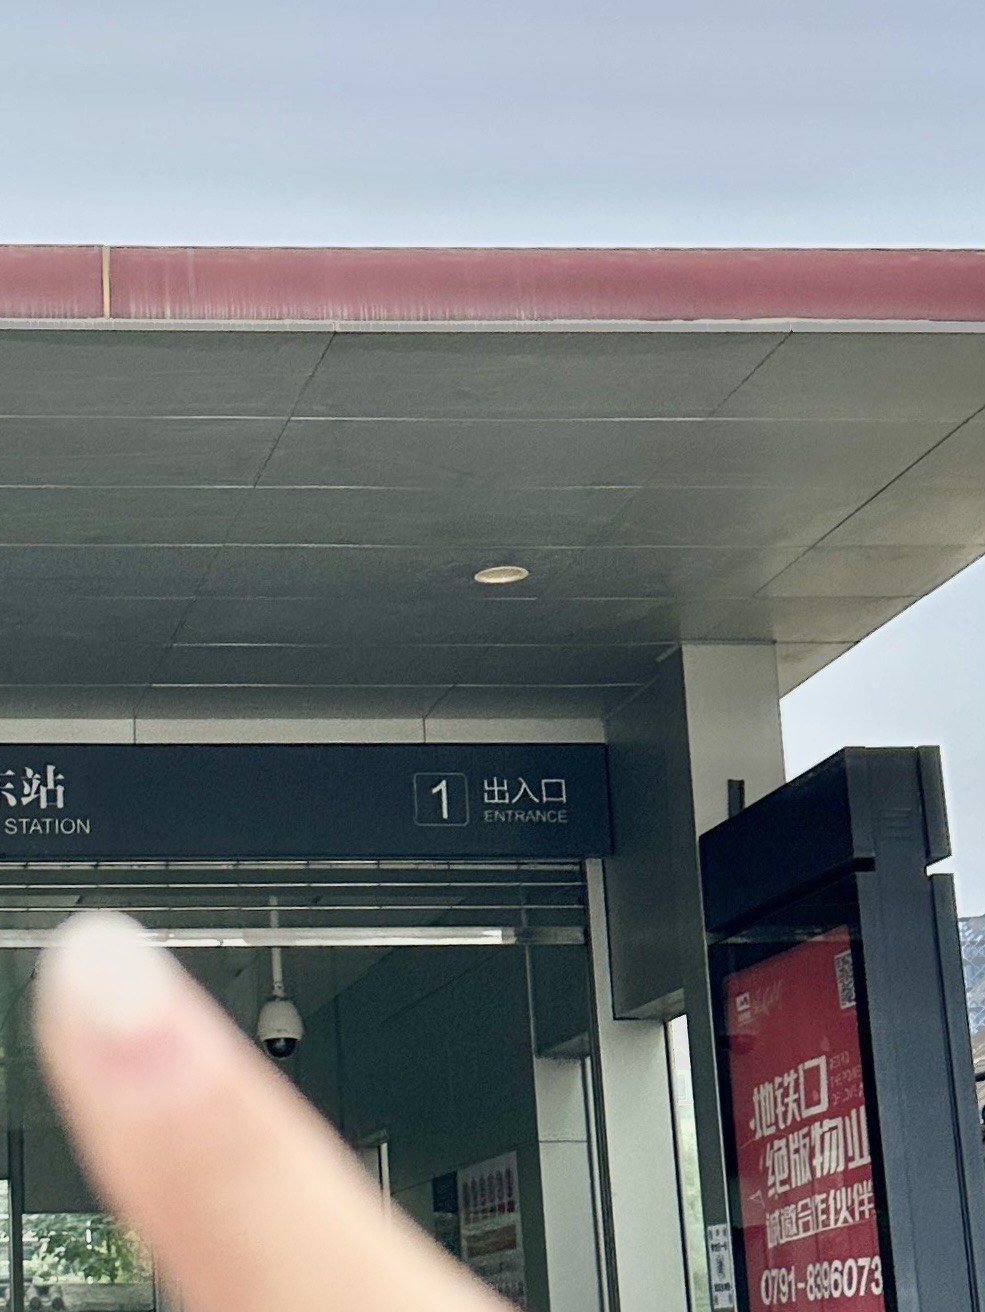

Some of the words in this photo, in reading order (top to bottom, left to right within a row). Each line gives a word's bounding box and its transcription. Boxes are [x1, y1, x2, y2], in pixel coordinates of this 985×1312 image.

[431, 779, 449, 820] 1
[483, 776, 567, 804] 出入口
[5, 818, 91, 835] STATION
[483, 809, 568, 823] ENTRANCE
[749, 1054, 829, 1140] 地铁口
[763, 1104, 872, 1198] 绝版物业
